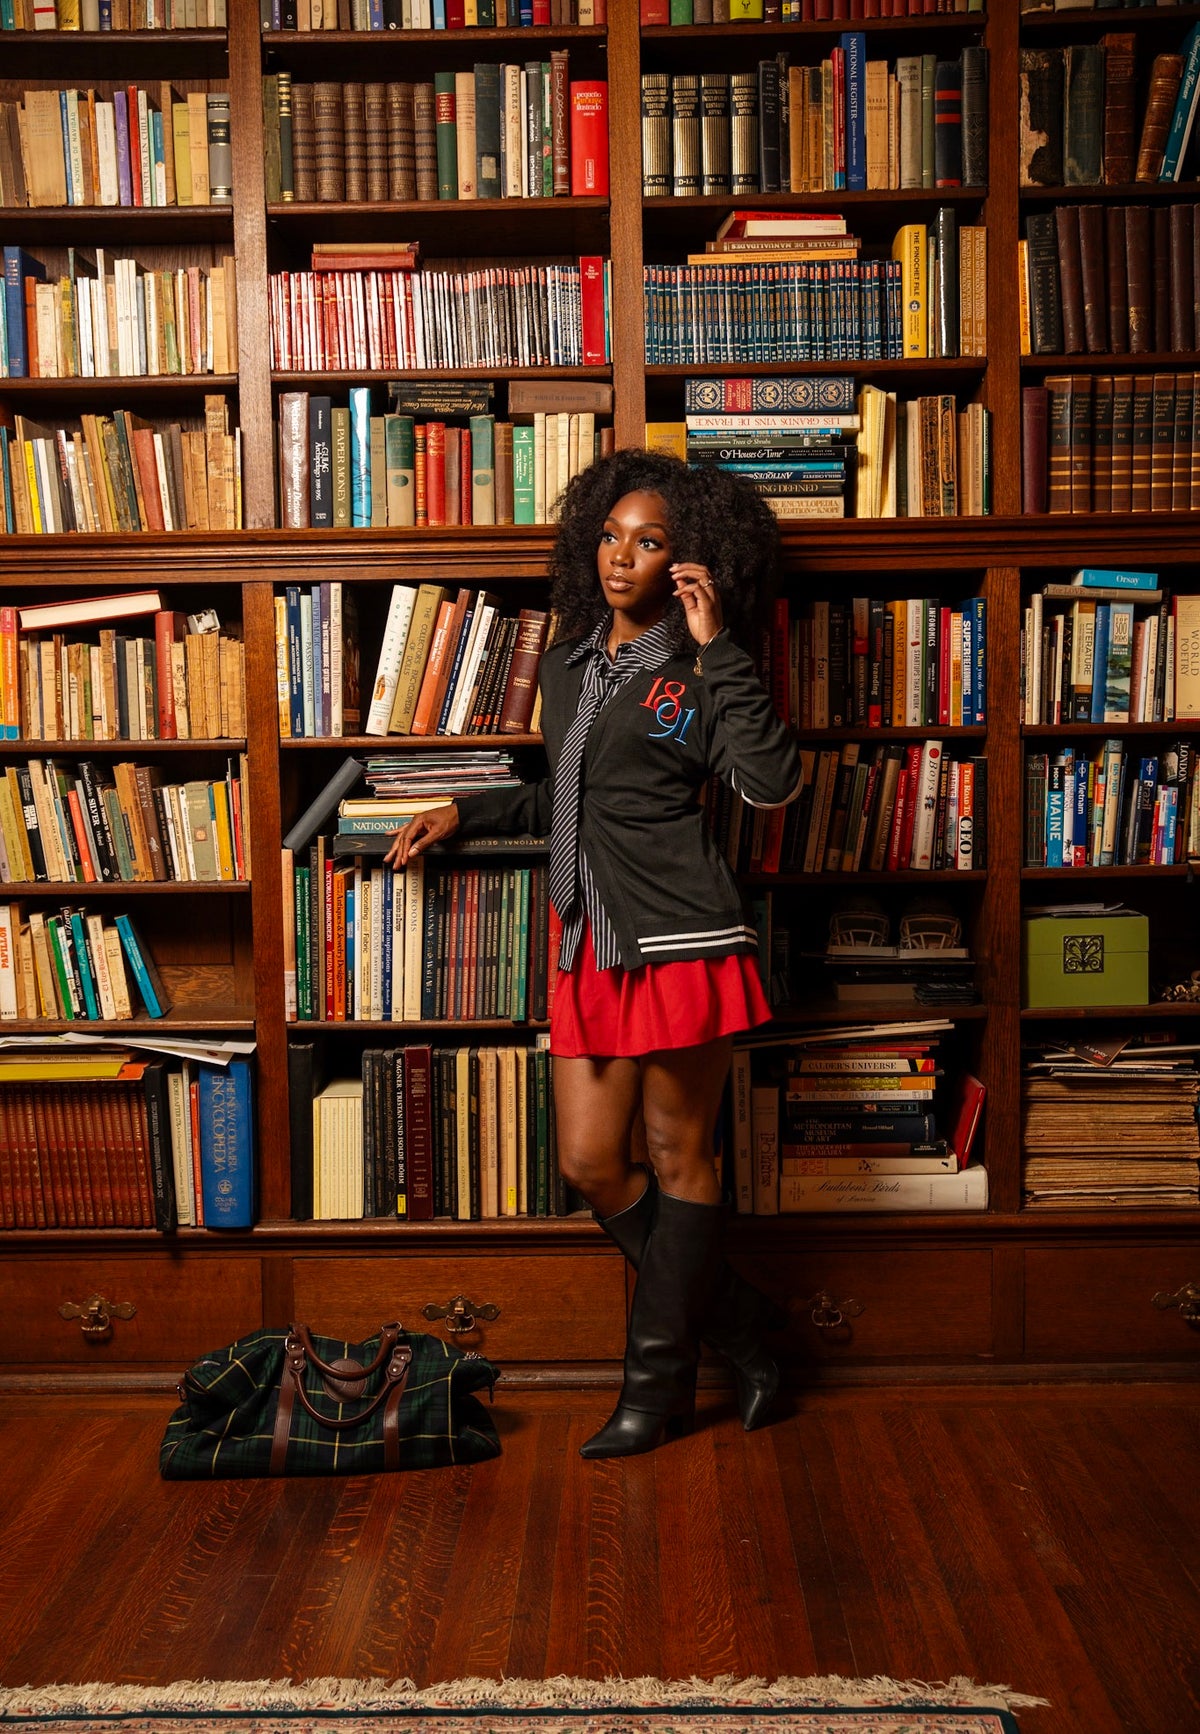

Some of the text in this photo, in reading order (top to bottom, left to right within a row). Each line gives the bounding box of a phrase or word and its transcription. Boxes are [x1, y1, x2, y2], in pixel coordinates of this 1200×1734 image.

[849, 38, 859, 120] NATIONAL REGISTER
[694, 418, 841, 427] LES GRANDS VINS DE FRANCE
[313, 442, 323, 479] Archipelago
[321, 447, 330, 473] GULAG
[336, 428, 347, 503] PAPER MONEY
[752, 471, 795, 480] ANTIQUES
[778, 484, 820, 493] DEFINED
[292, 491, 303, 528] Dictionary
[1115, 575, 1140, 586] Orsay
[312, 600, 321, 648] PAPER MAGIC
[927, 607, 937, 648] INFONOMICS
[977, 602, 985, 619] How
[394, 605, 413, 674] ELEMENTS
[1115, 623, 1128, 635] 500
[402, 606, 433, 716] THE COLLECTORS ENCYCLOPEDIA
[403, 641, 417, 677] OF DOLLS
[896, 620, 905, 710] SMART LUCKY?
[913, 649, 921, 677] STARTUPS
[977, 649, 985, 668] What
[1083, 622, 1094, 676] LITERATURE
[1180, 638, 1190, 677] POETRY
[1190, 629, 1200, 676] WORLD
[305, 641, 314, 704] PASSION DETAIL
[817, 657, 828, 681] four
[870, 662, 881, 696] branding
[927, 760, 938, 793] Boys
[940, 760, 949, 798] BIG BRANDS
[1178, 744, 1190, 783] LONDON
[136, 772, 150, 808] LATIN
[949, 769, 957, 798] LEADING
[1077, 780, 1087, 816] Vietnam
[1141, 779, 1154, 810] Brazil
[87, 797, 102, 827] SILVER
[351, 821, 399, 831] NATIONAL
[1049, 793, 1063, 842] MAINE
[1168, 815, 1177, 839] French
[503, 838, 546, 847] NATIONAL
[891, 825, 901, 859] OPPORTUNITY
[959, 816, 974, 855] CEO
[325, 869, 333, 904] VICTORIAN
[62, 909, 74, 930] Zorro
[325, 904, 333, 943] EMBROIDERY
[335, 894, 346, 925] Antiques
[361, 883, 371, 954] Decorating Fabric
[410, 898, 419, 932] ROOMS
[0, 926, 10, 969] PAPILLON
[384, 908, 394, 973] Interior Inspirations
[335, 959, 345, 989] Designs
[808, 1062, 897, 1072] CALDER'S UNIVERSE
[211, 1075, 226, 1174] ENCYCLOPEDIA
[226, 1077, 238, 1173] THE NEW COLUMBIA
[793, 1122, 853, 1130] METROPOLITAN
[803, 1129, 838, 1137] MUSEUM
[759, 1132, 778, 1187] Politics
[814, 1182, 903, 1193] Audubon's Birds
